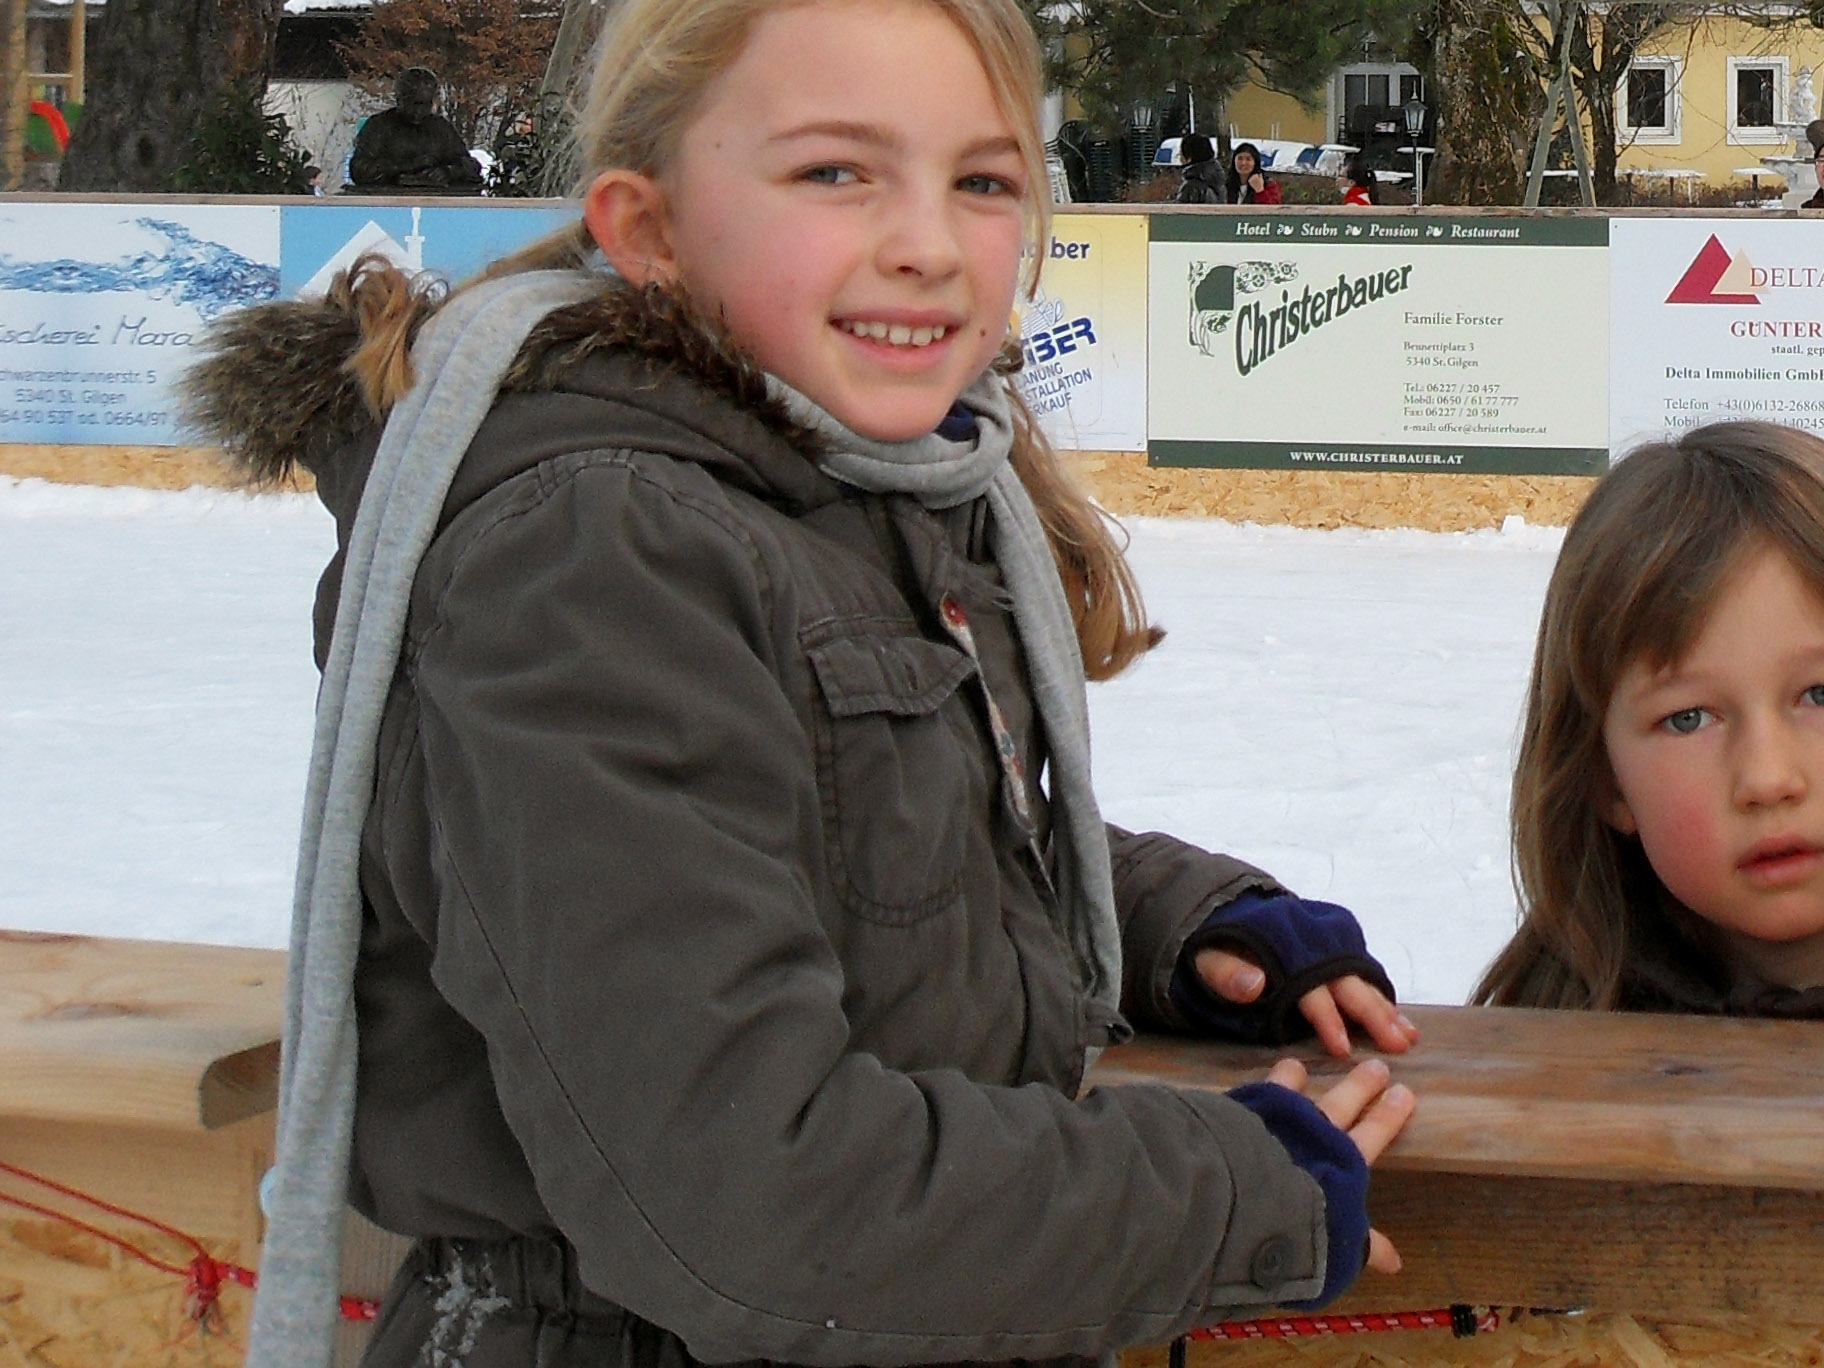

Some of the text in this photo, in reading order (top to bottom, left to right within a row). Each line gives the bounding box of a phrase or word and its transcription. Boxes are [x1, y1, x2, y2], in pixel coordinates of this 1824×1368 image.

[1235, 222, 1521, 239] Hotel Stubn Pension Restaurant
[1235, 264, 1413, 377] Christerbauer
[1403, 311, 1504, 326] Familie Forster
[1469, 342, 1475, 352] 3
[1770, 344, 1804, 356] staatl.
[1405, 356, 1431, 367] 5340
[1446, 357, 1479, 369] Gilgen
[148, 370, 157, 384] 5
[1664, 366, 1701, 381] Delta
[1705, 367, 1782, 382] Immobilien
[1426, 383, 1457, 393] 06227
[1467, 384, 1480, 394] 20
[1481, 384, 1501, 395] 457
[16, 389, 55, 403] 5340
[83, 390, 128, 407] Gilgen
[1403, 395, 1435, 405] Mobil:
[1436, 395, 1462, 406] 0650
[1471, 396, 1484, 406] 61
[1486, 396, 1498, 407] 77
[1500, 396, 1519, 407] 777
[1663, 398, 1710, 411] Telefon
[1403, 407, 1424, 417] Fax:
[1425, 407, 1456, 418] 06227
[1466, 408, 1479, 418] 20
[1480, 408, 1499, 418] 589
[1403, 422, 1548, 435] e-mail: office@christerbauer.at
[1663, 415, 1701, 429] Mobil
[1289, 450, 1465, 465] WWW.CHRISTERBAUER.AT
